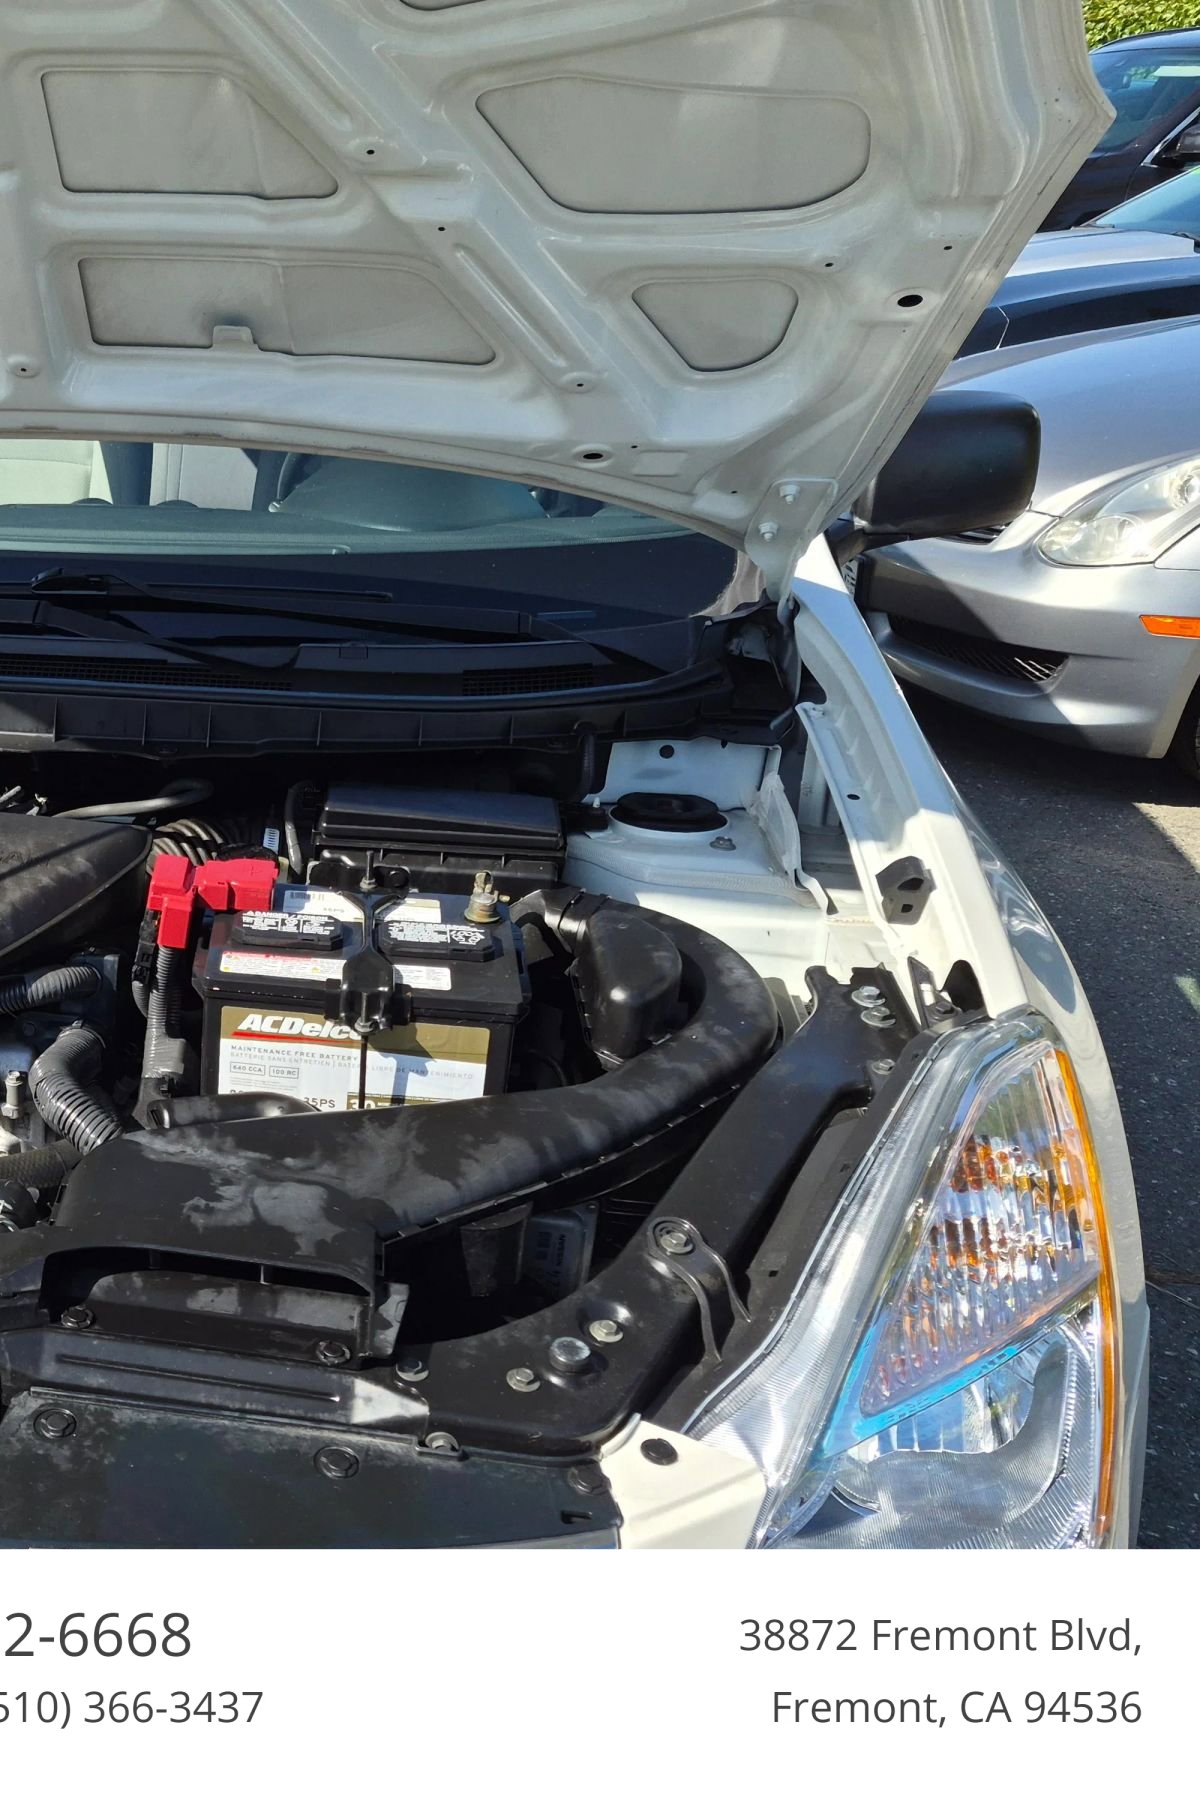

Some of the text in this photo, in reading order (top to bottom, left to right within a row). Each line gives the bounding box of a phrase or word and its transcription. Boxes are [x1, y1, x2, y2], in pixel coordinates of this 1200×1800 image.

[231, 1045, 359, 1062] MAINTENANCE FREE BATTERY
